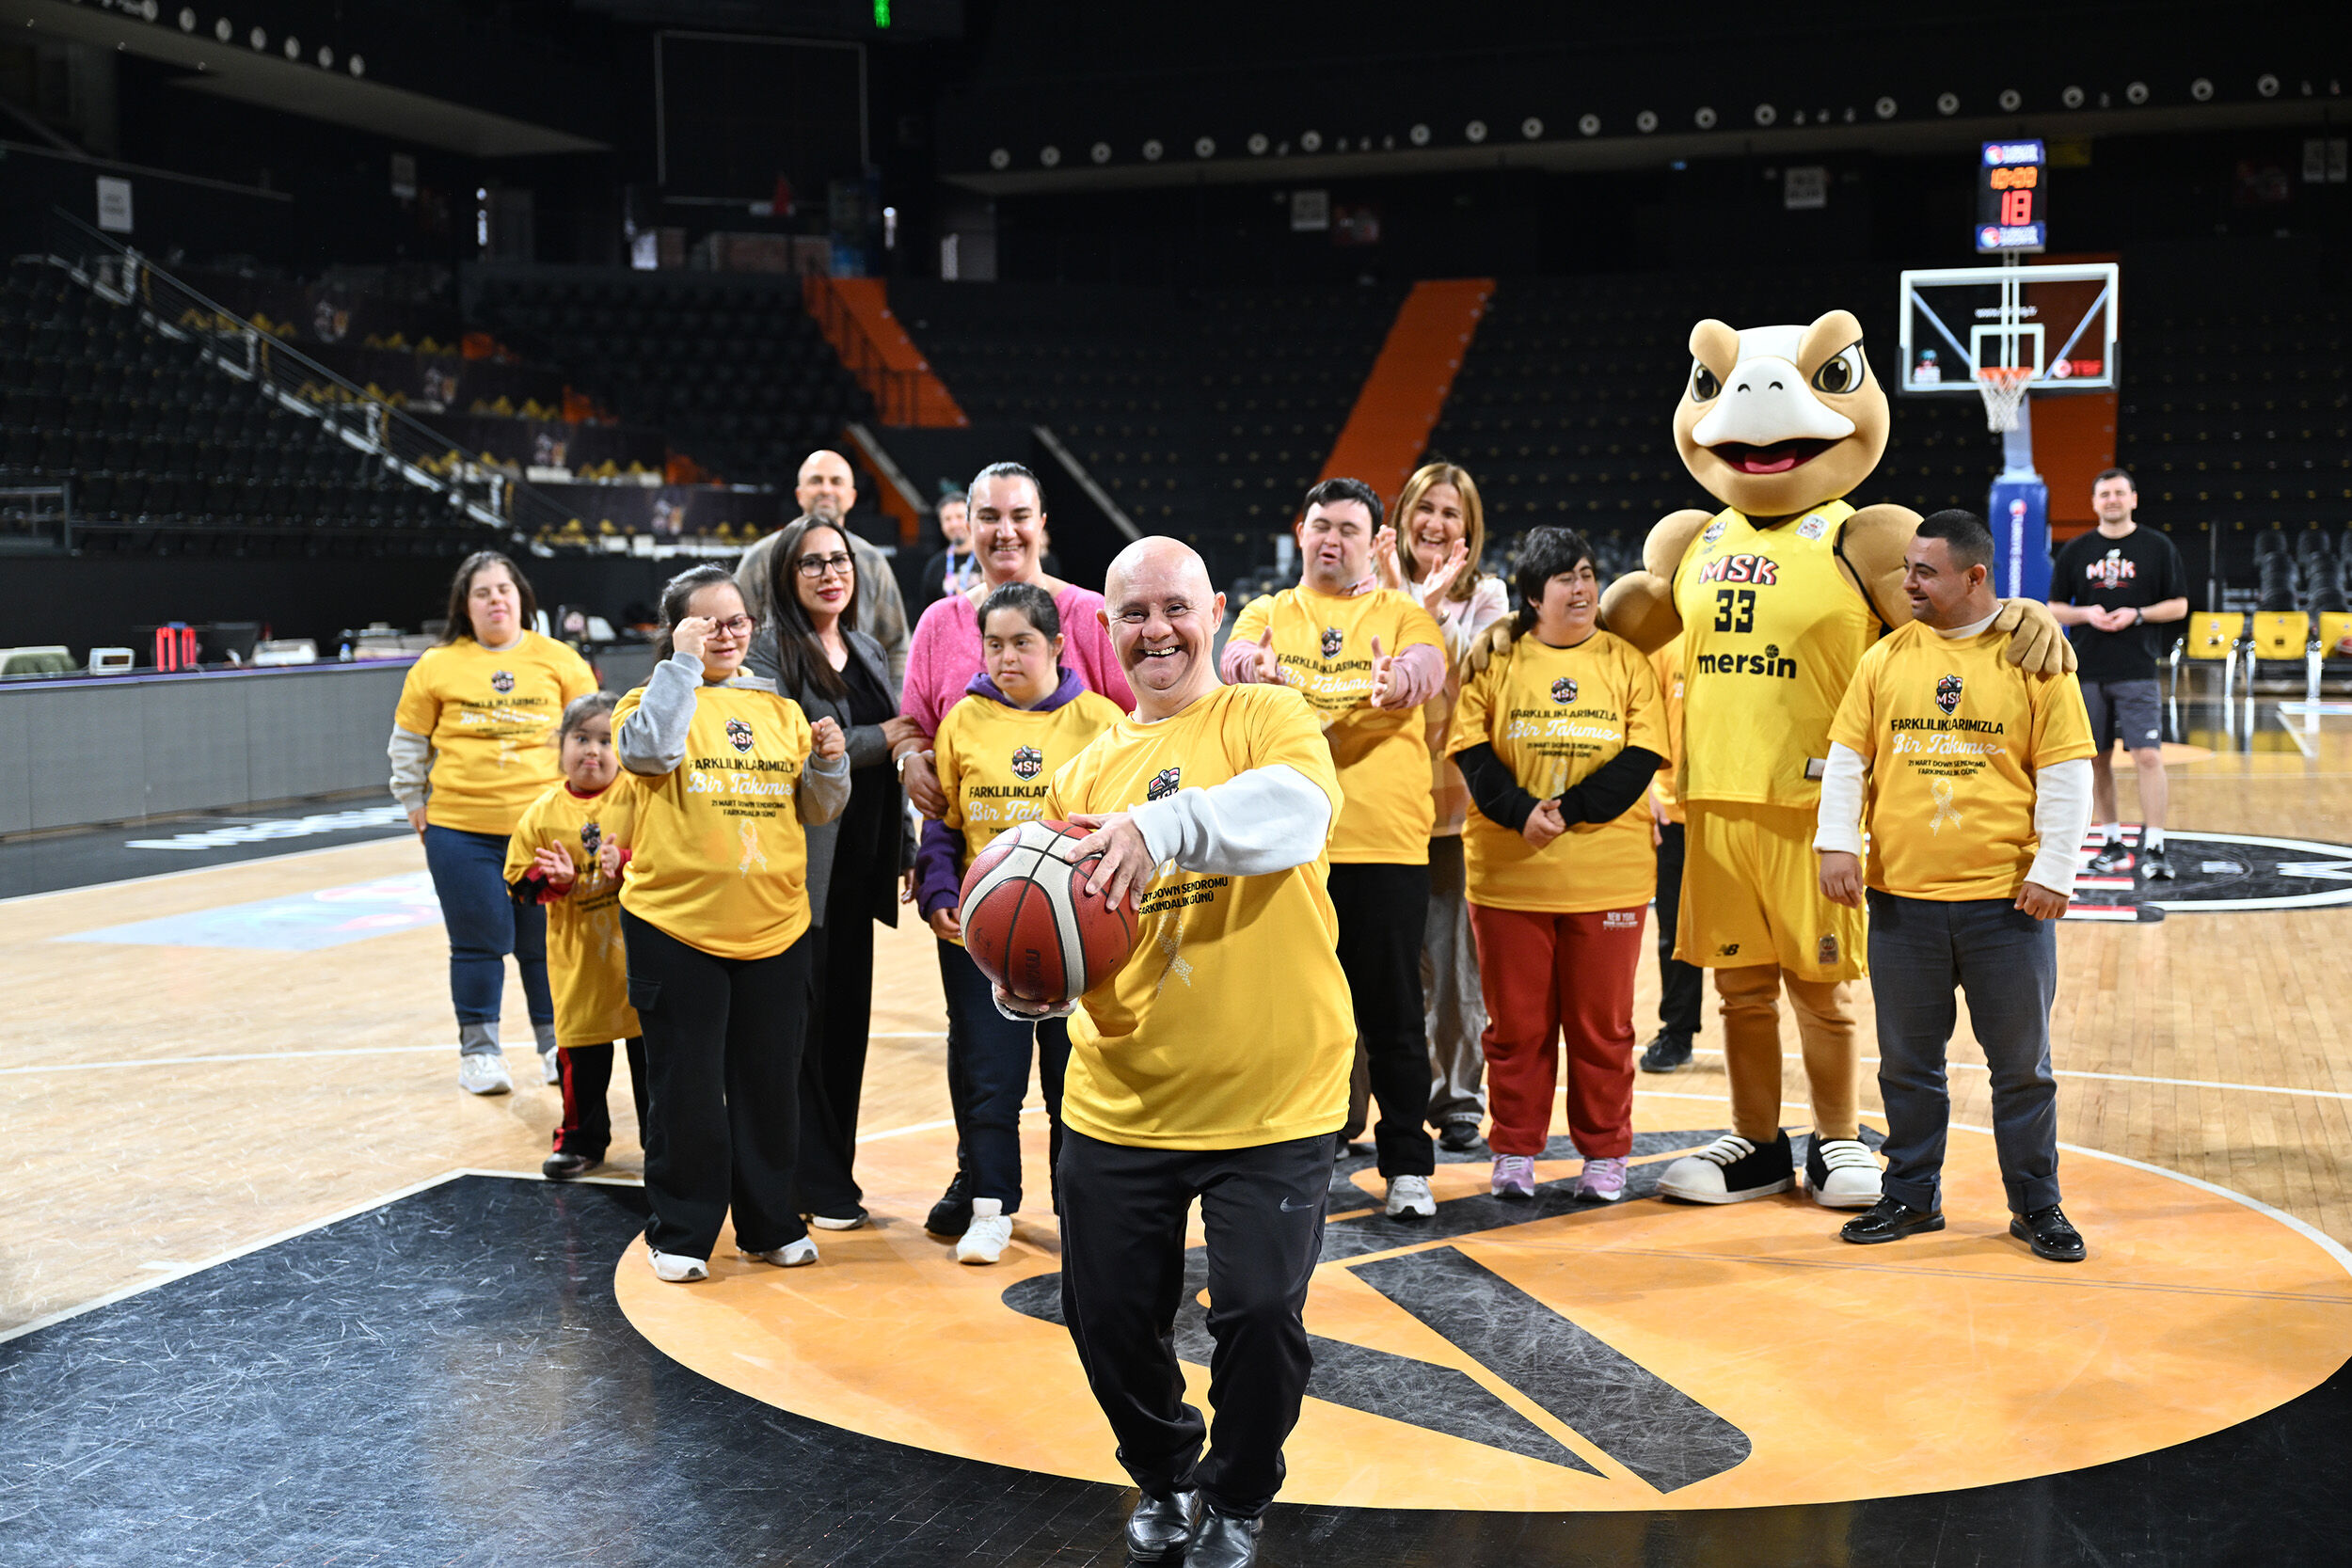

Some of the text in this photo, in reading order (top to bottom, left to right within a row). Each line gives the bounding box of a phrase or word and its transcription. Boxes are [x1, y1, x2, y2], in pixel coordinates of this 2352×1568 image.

[2001, 190, 2032, 226] 18
[1699, 554, 1779, 585] MSK
[2087, 558, 2137, 579] MSK
[1714, 590, 1756, 633] 33
[1697, 644, 1797, 679] mersin
[1507, 719, 1622, 741] Bir Takımız
[1891, 719, 2004, 734] FARKLILIKLARIMIZLA
[1893, 734, 2006, 754] Bir Takımız
[1012, 761, 1042, 772] MSK
[687, 771, 724, 792] Bir
[969, 801, 1001, 820] Bir
[1140, 892, 1153, 903] ART
[1182, 877, 1229, 894] SENDROMU
[1189, 890, 1214, 905] GÜNÜ
